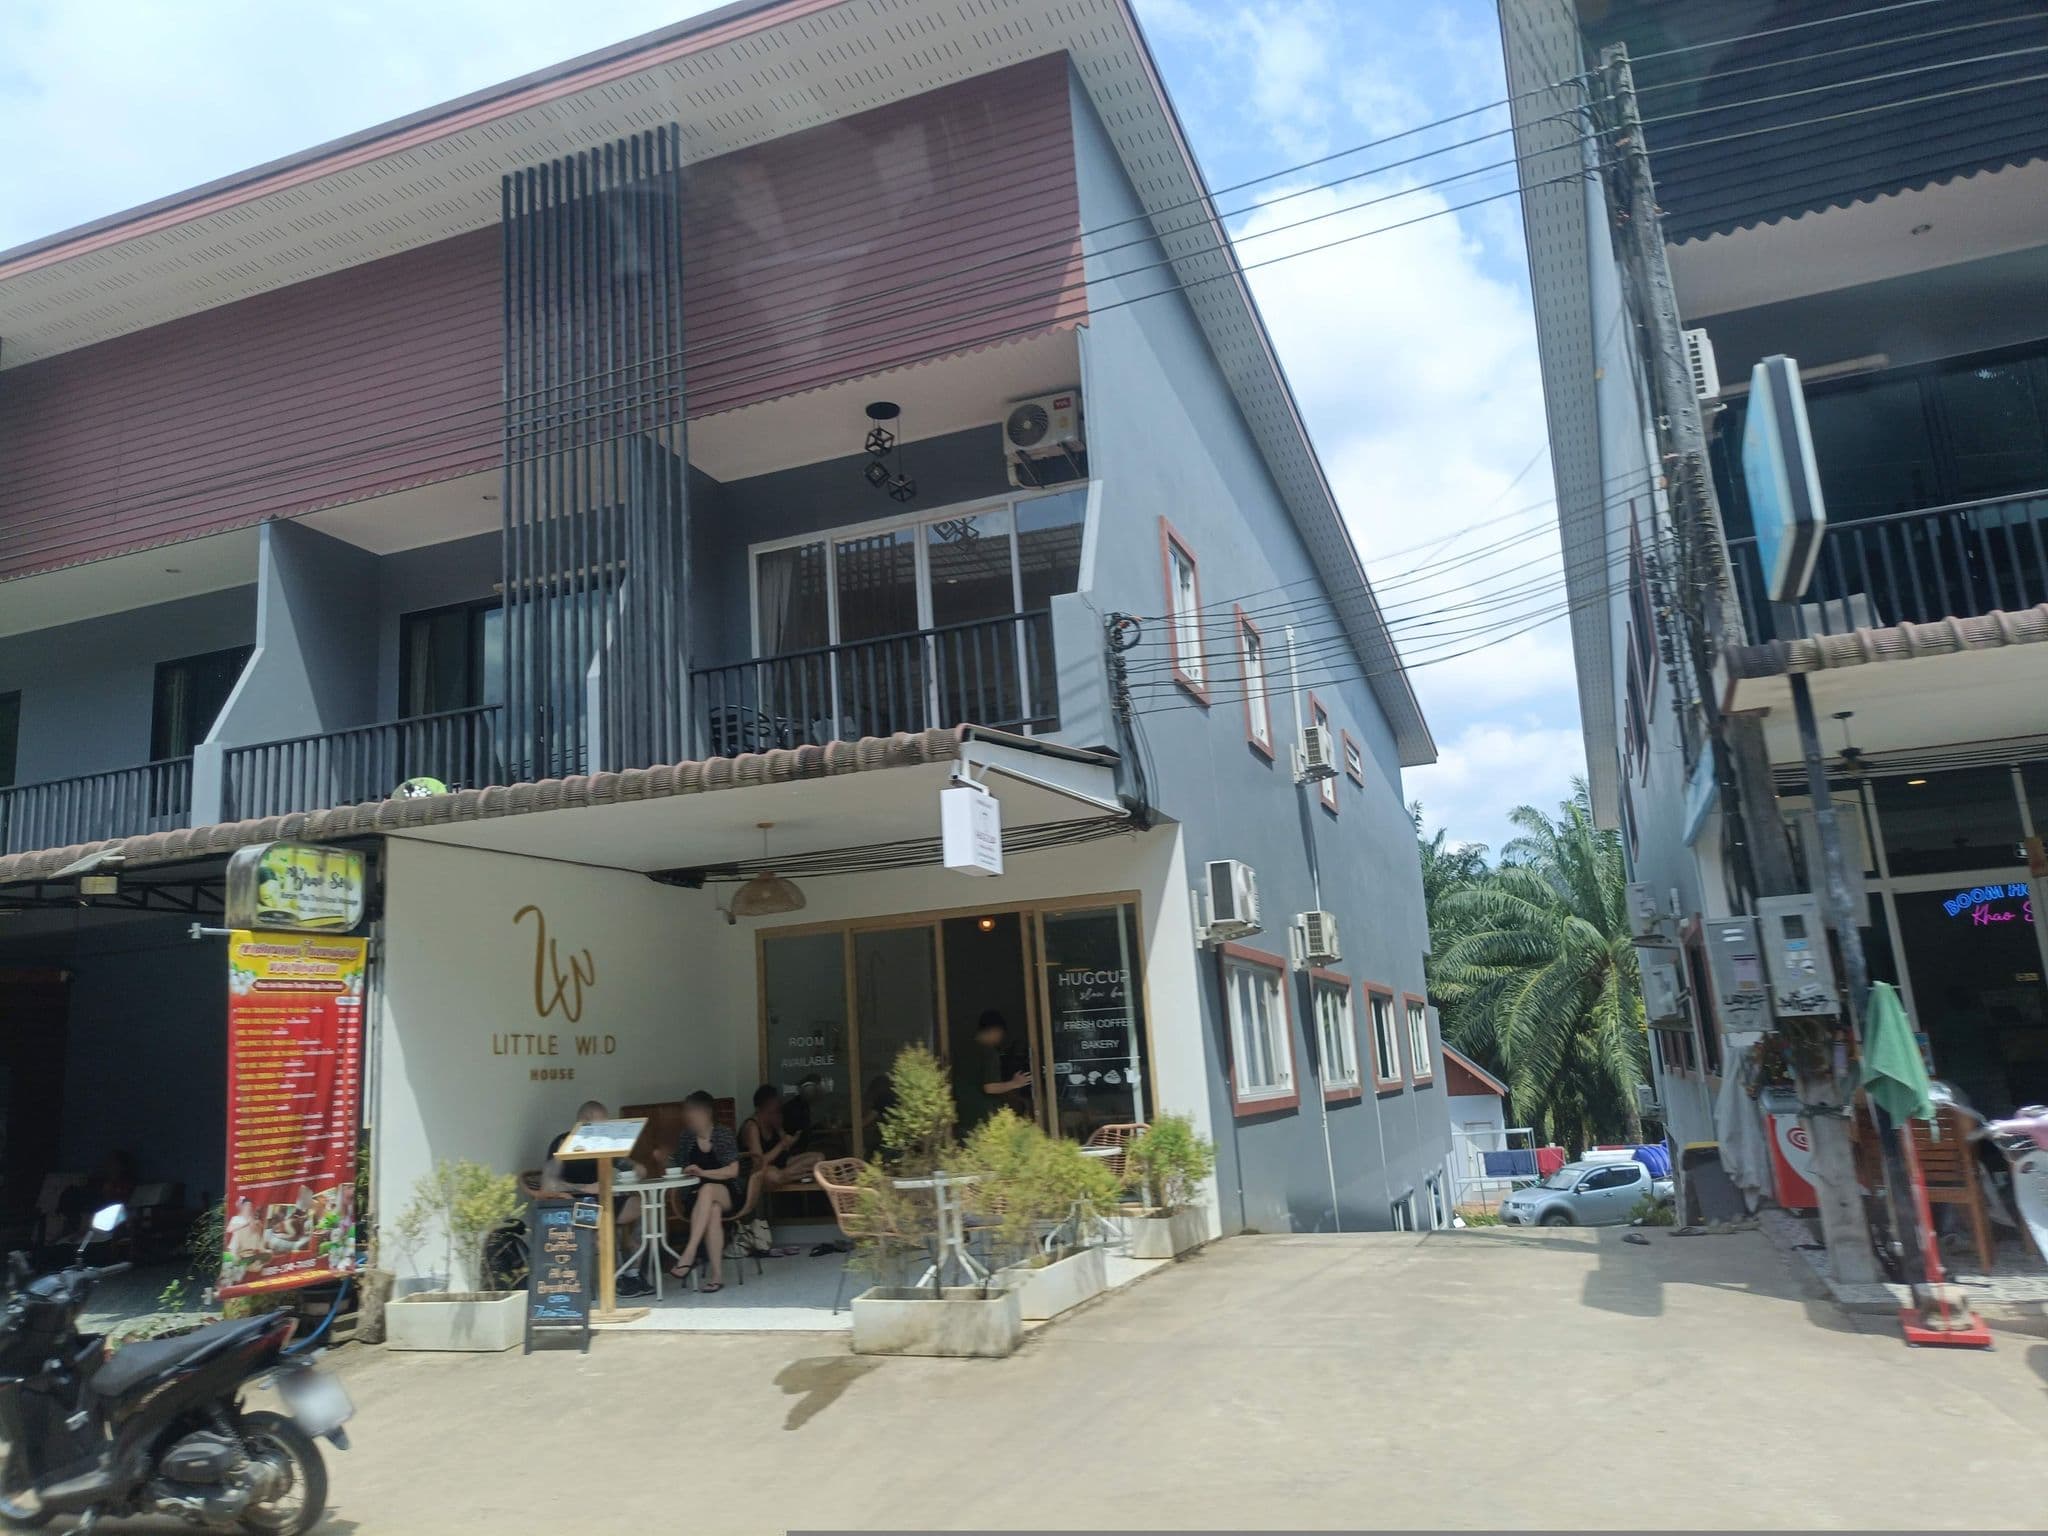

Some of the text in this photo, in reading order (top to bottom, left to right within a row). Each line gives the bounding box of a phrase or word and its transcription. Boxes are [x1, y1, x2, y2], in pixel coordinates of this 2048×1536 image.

[1943, 885, 2005, 916] BOOM
[1971, 904, 2016, 925] Khao
[1059, 970, 1130, 986] HUGCUP
[1063, 1020, 1095, 1031] FRESH
[493, 1033, 558, 1055] LITTLE
[789, 1036, 825, 1048] ROOM
[1081, 1039, 1120, 1049] BAKERY
[782, 1055, 835, 1067] AVAILABLE
[529, 1067, 576, 1081] HOUSE
